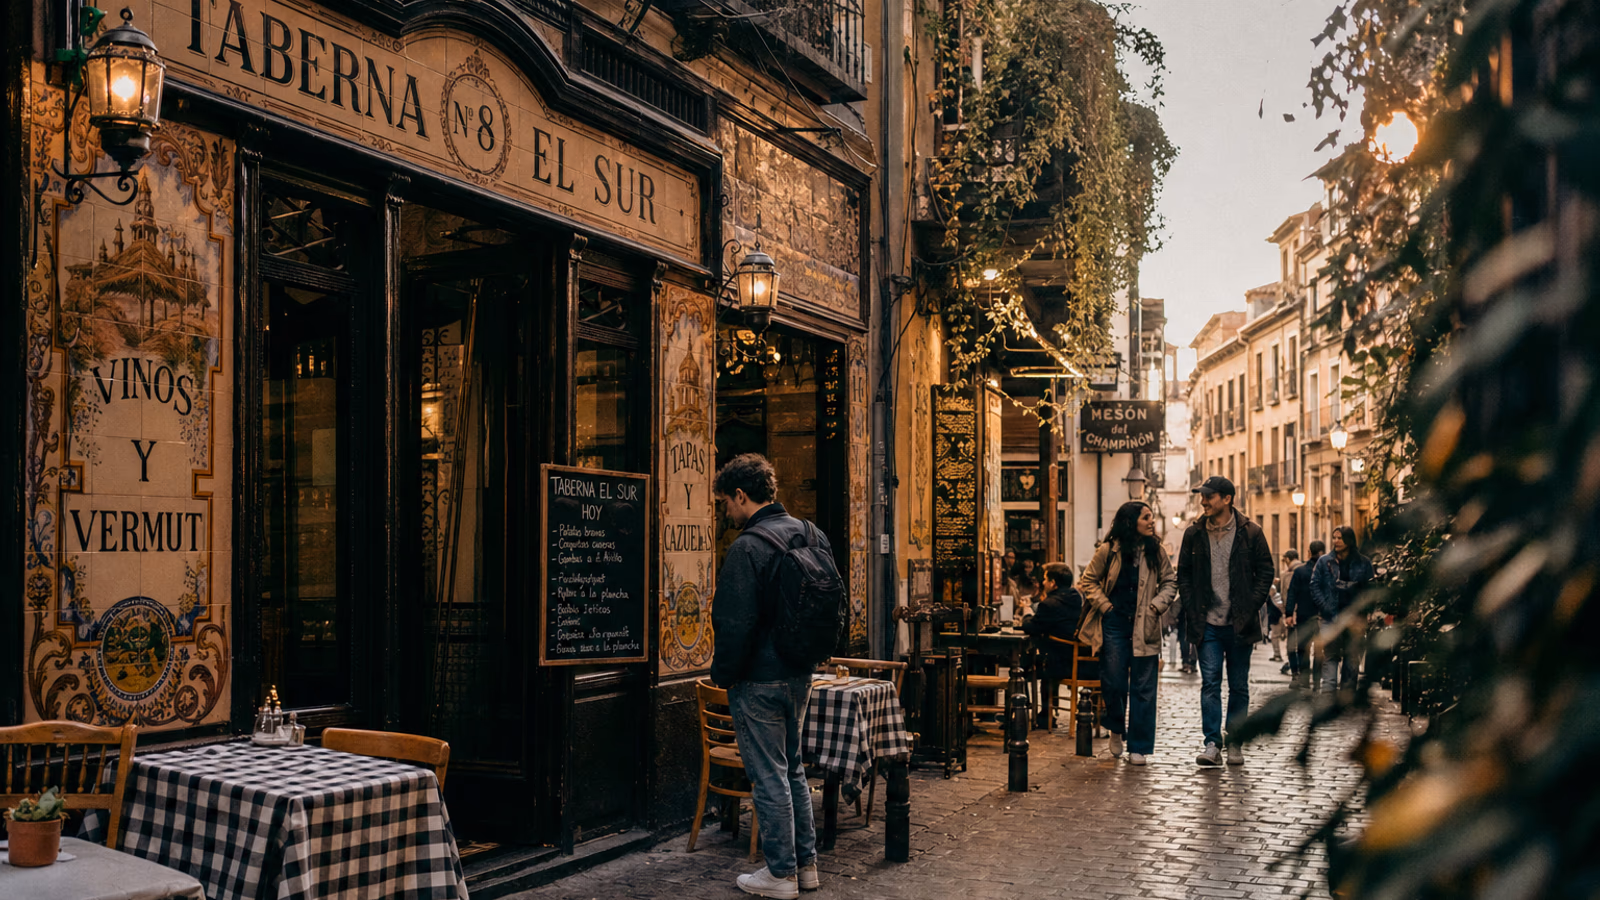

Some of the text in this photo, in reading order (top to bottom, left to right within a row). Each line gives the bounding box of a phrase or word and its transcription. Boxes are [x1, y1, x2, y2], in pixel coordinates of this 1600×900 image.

[187, 0, 430, 140] TABERNA
[477, 105, 495, 151] 8
[532, 126, 657, 225] EL SUR
[93, 357, 194, 416] VINOS
[1111, 423, 1128, 435] del
[131, 440, 157, 482] Y
[670, 441, 705, 475] TAPAS
[550, 476, 638, 502] TABERNA EL SUR
[683, 483, 693, 510] Y
[69, 509, 203, 552] VERMUT
[581, 504, 603, 521] HOY
